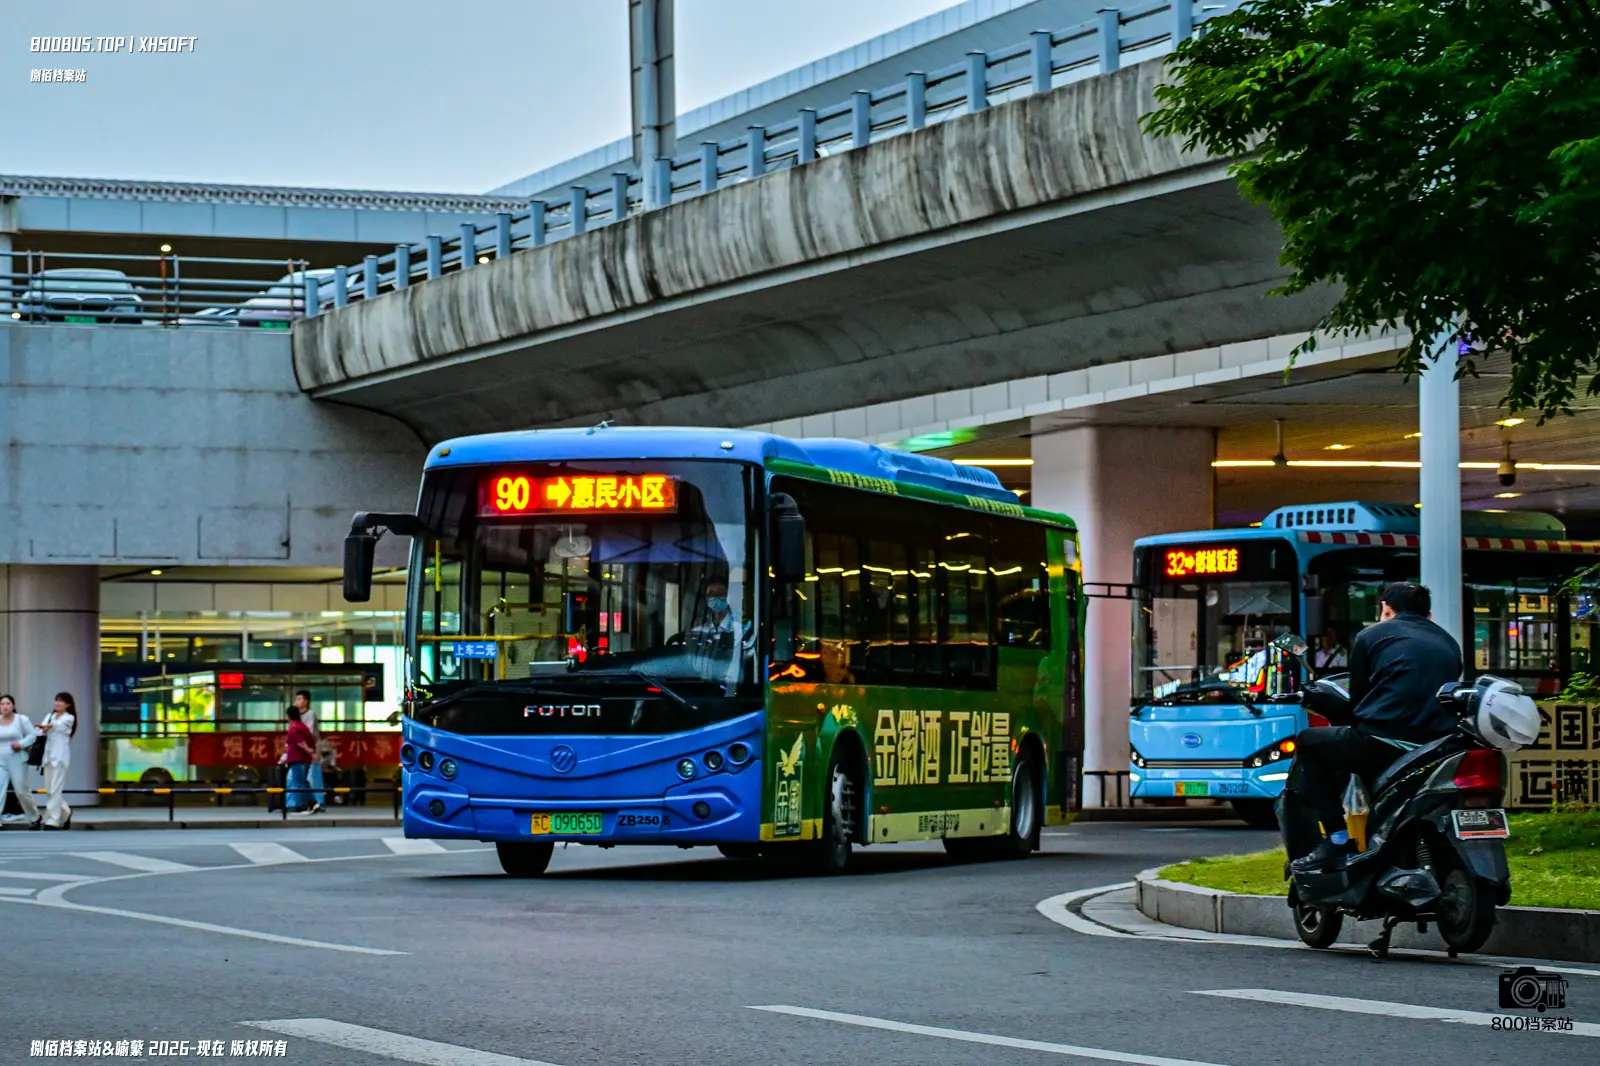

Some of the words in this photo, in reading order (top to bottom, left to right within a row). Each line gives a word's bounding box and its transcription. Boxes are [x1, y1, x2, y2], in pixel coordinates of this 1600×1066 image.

[496, 477, 530, 510] 90
[571, 476, 666, 508] 惠民小区
[1167, 551, 1187, 576] 32
[454, 642, 497, 658] 上车二元
[523, 704, 601, 718] FOTON
[874, 709, 942, 786] 金徽酒
[947, 710, 1012, 784] 正能量
[1520, 759, 1600, 804] 运满
